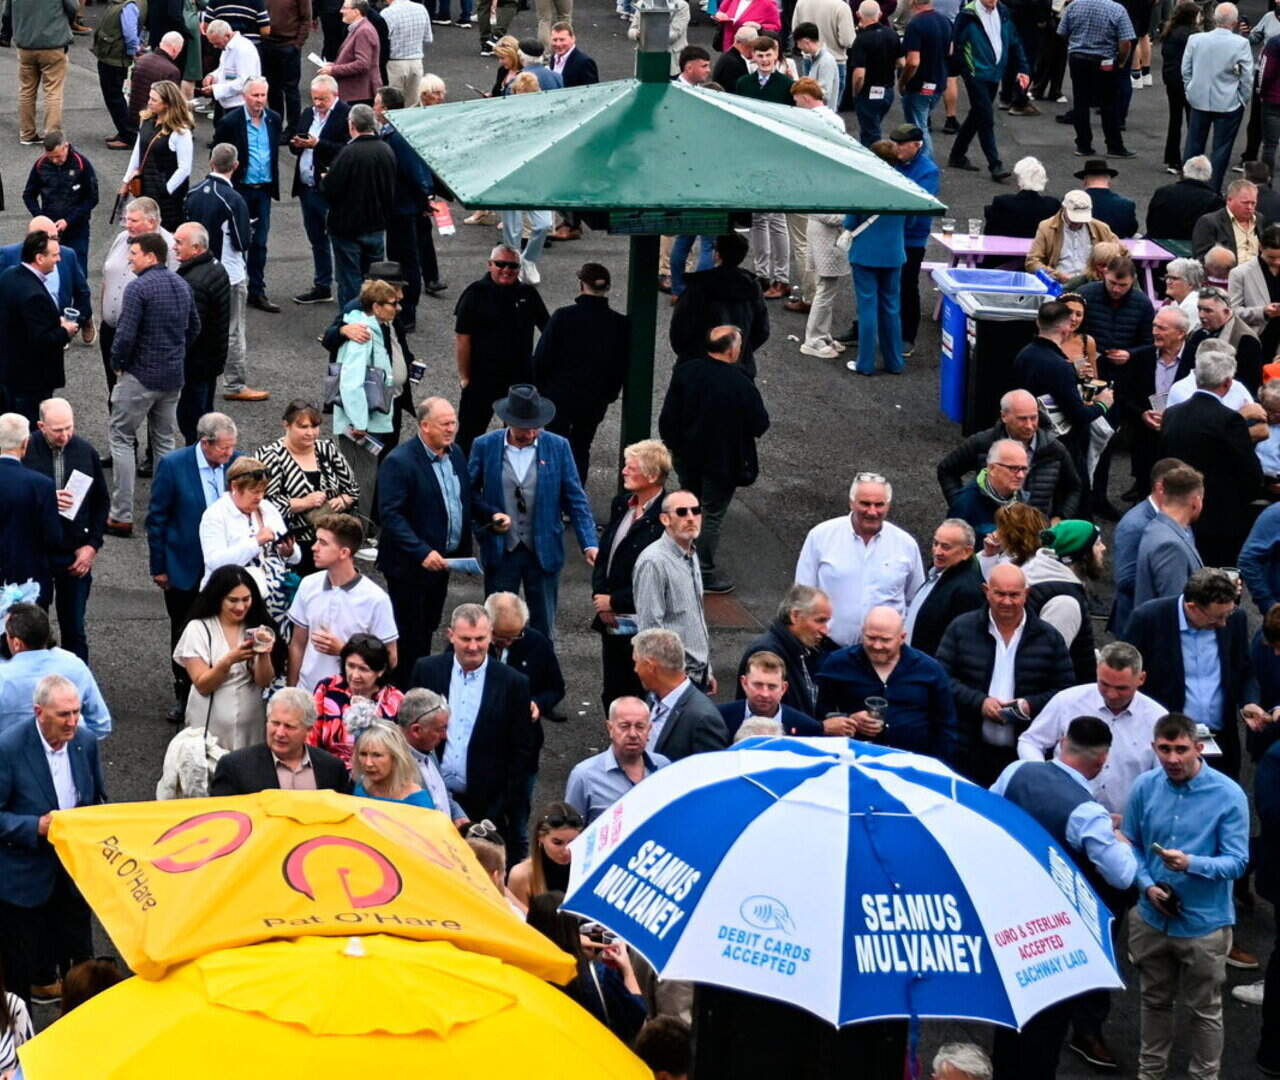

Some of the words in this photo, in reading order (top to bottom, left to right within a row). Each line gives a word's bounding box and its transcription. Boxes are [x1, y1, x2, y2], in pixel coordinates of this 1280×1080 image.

[99, 836, 121, 862] Pat
[116, 858, 157, 912] O'Hare
[627, 839, 702, 903] SEAMUS
[263, 914, 321, 929] Pat
[334, 912, 463, 931] O'Hare
[592, 863, 686, 941] MULVANEY
[861, 893, 963, 932] SEAMUS
[717, 925, 761, 947] DEBIT
[764, 936, 812, 962] CARDS
[1019, 925, 1028, 938] &
[1028, 911, 1072, 935] STERLING
[721, 943, 797, 976] ACCEPTED
[854, 934, 983, 975] MULVANEY
[1017, 935, 1064, 961] ACCEPTED
[1015, 956, 1066, 988] EACHWAY
[1066, 949, 1089, 968] LAID
